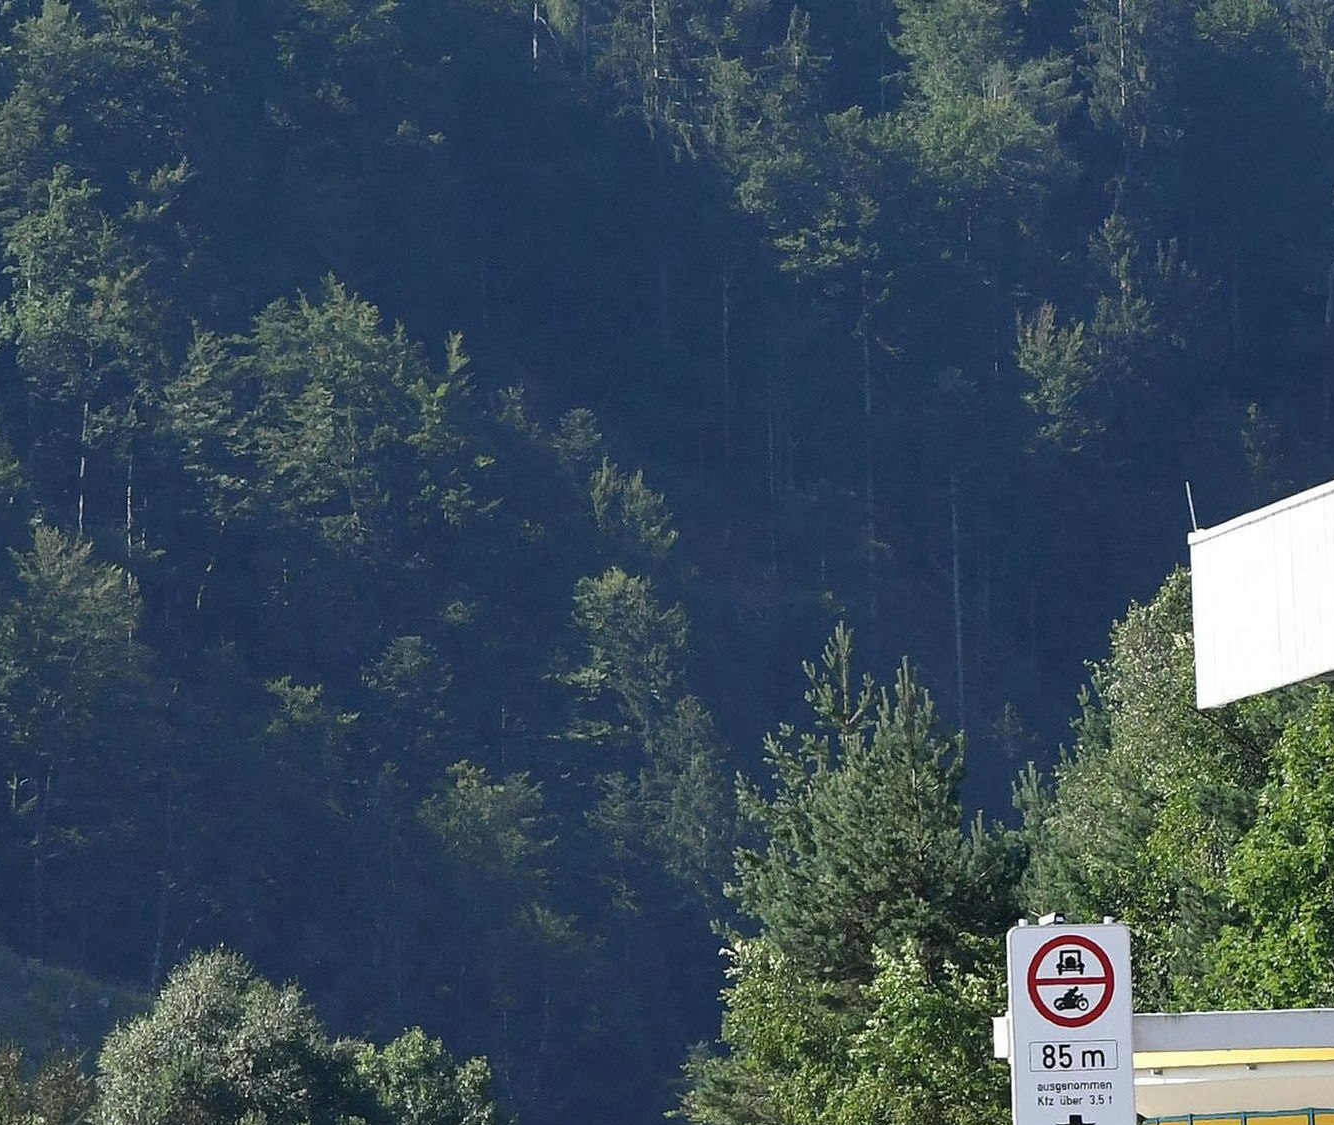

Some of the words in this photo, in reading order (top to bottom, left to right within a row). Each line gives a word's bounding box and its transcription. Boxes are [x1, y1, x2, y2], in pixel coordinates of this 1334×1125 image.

[1042, 1044, 1073, 1069] 85
[1081, 1050, 1105, 1068] m
[1037, 1081, 1112, 1093] ausgenommen
[1037, 1095, 1054, 1106] Kfz
[1059, 1095, 1083, 1106] über
